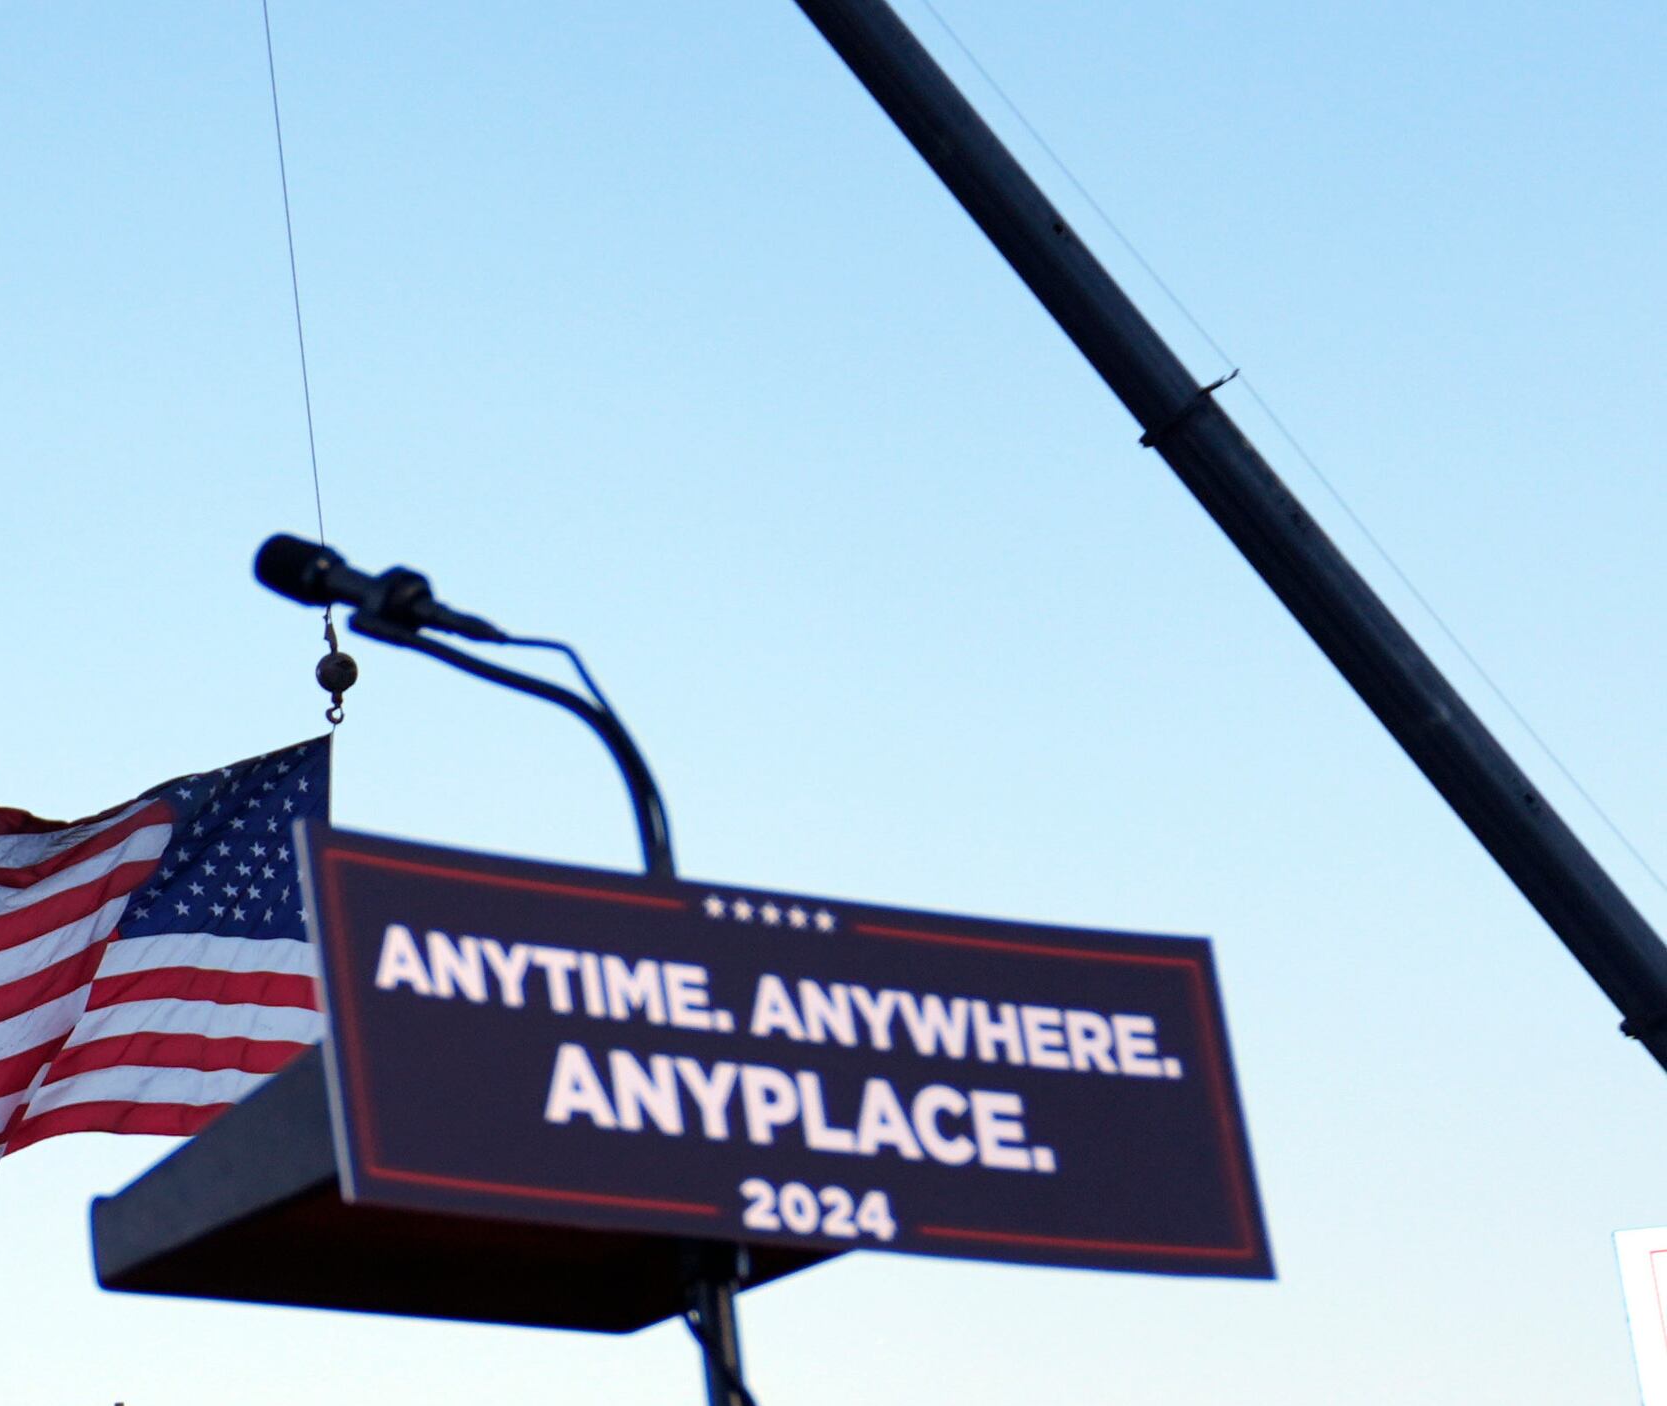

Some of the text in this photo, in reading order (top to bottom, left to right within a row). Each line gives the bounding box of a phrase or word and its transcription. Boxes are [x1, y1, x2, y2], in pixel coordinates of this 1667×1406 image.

[376, 924, 1182, 1079] ANYTIME. ANYWHERE.
[544, 1044, 1056, 1173] ANYPLACE.
[740, 1179, 896, 1241] 2024
